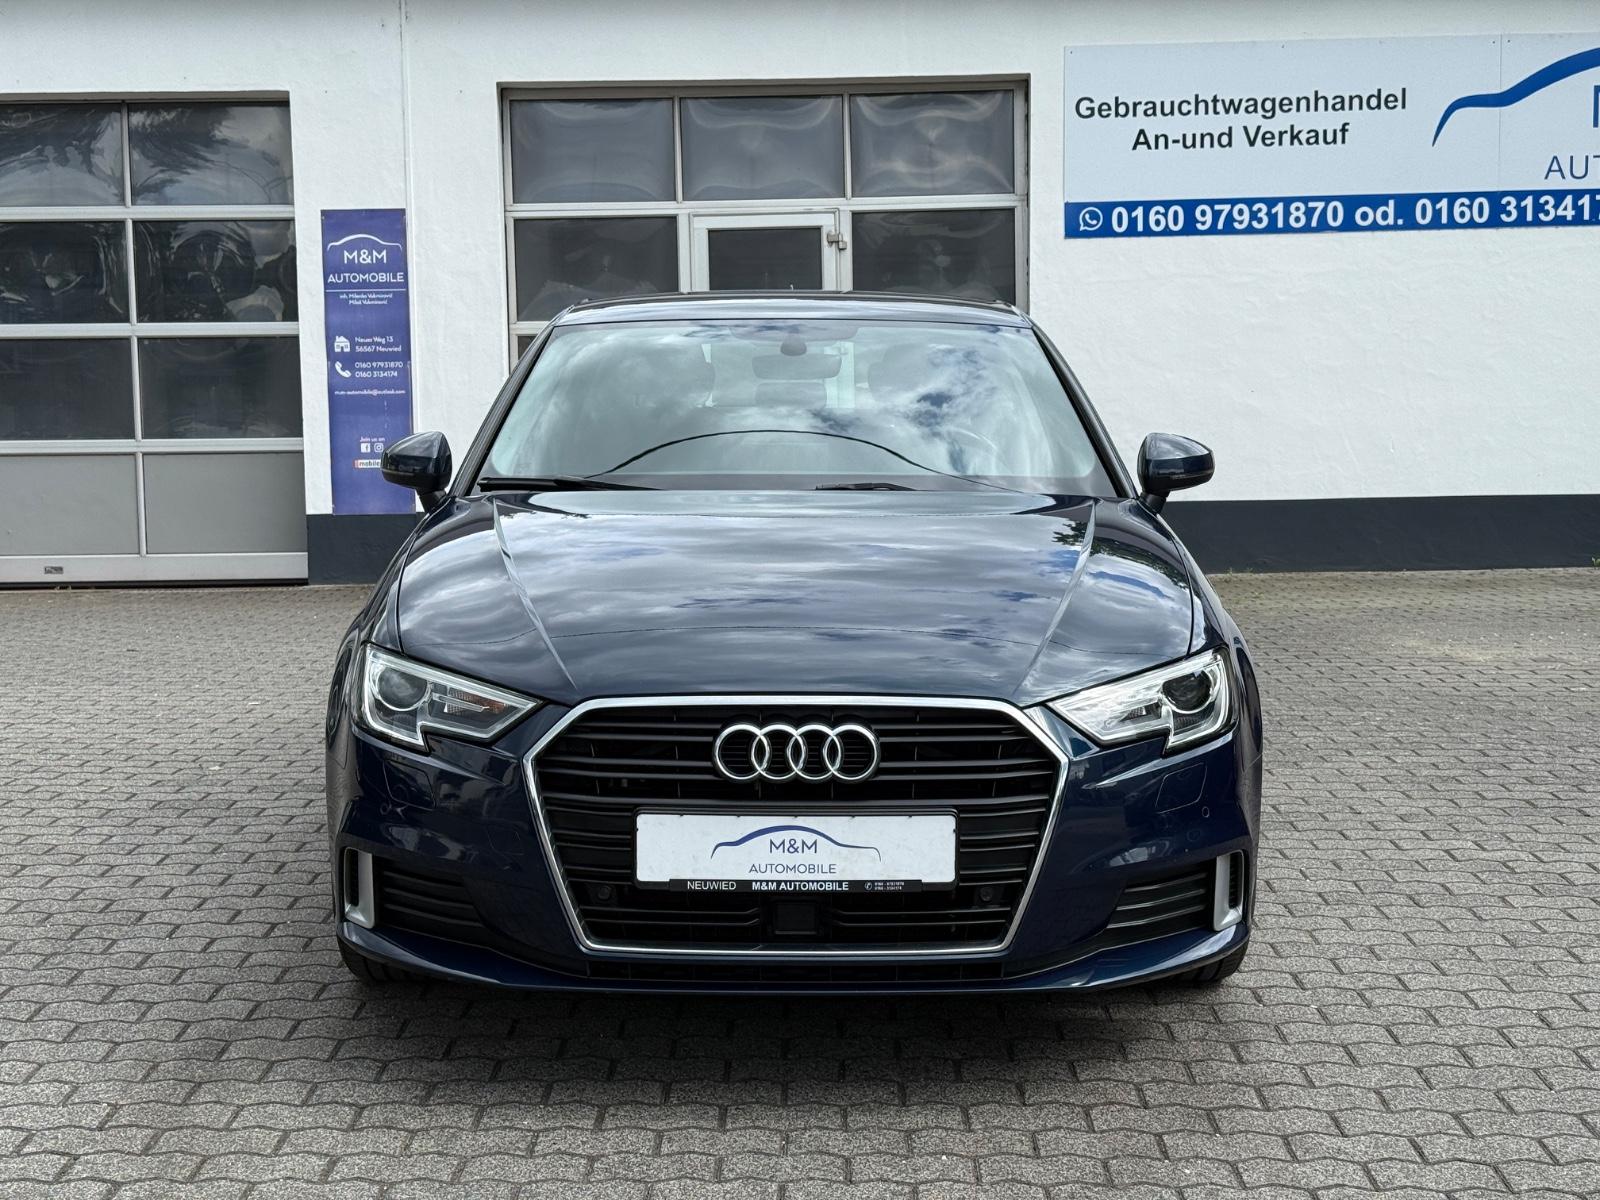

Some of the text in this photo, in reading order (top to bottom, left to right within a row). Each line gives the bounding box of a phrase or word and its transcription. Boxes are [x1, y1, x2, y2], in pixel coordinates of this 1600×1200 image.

[1074, 87, 1408, 120] Gebrauchtwagenhandel
[1131, 122, 1350, 151] An-und Verkauf
[1111, 205, 1185, 233] 0160
[1194, 201, 1344, 231] 97931870
[1354, 200, 1404, 227] od.
[1414, 196, 1490, 225] 0160
[343, 249, 388, 264] M&M
[327, 272, 405, 283] AUTOMOBILE
[354, 361, 372, 369] 0160
[769, 838, 818, 854] M&M
[748, 863, 837, 874] AUTOMOBILE
[687, 881, 849, 891] NEUWIED M&M AUTOMOBILE
